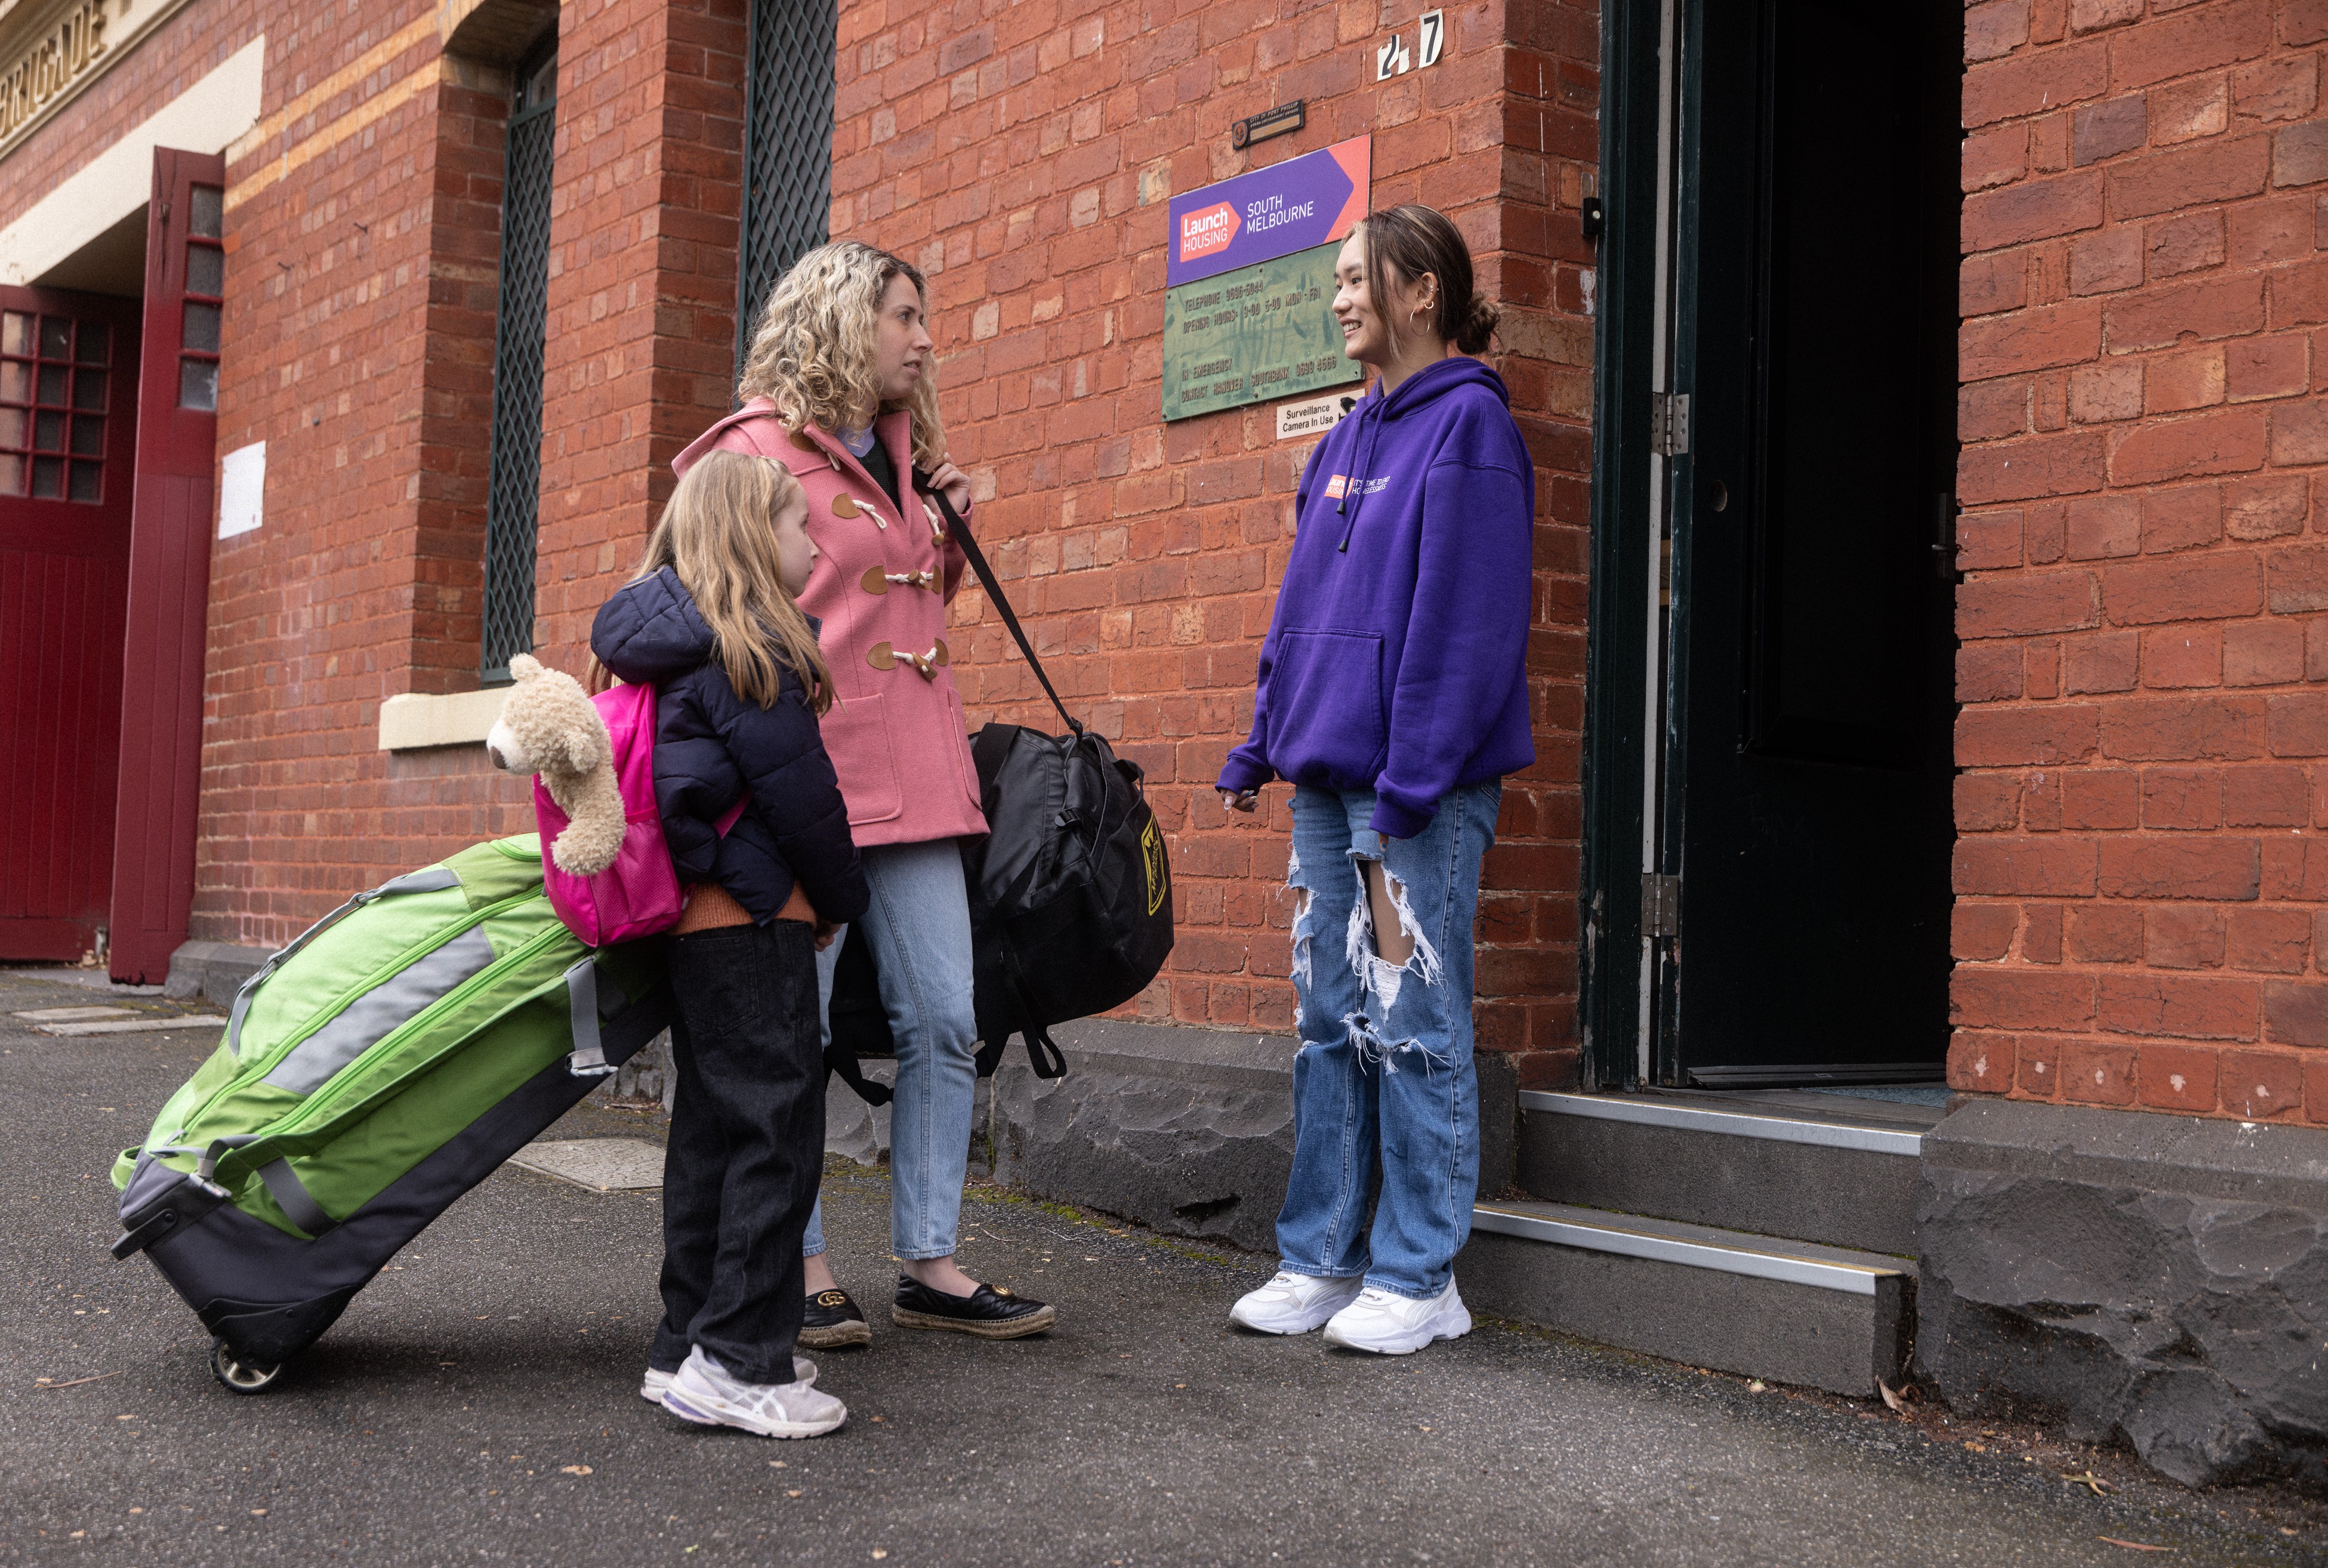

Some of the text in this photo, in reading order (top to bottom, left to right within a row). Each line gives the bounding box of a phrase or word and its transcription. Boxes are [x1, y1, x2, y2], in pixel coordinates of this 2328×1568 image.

[1268, 108, 1279, 116] PORT
[1281, 101, 1298, 112] PHILLIP
[1247, 193, 1282, 218] SOUTH
[1247, 200, 1314, 234] MELBOURNE
[1184, 207, 1228, 237] Launch
[1183, 227, 1228, 253] HOUSING
[1183, 315, 1210, 334] OPENING
[1285, 290, 1301, 307] MON
[1309, 285, 1321, 301] FRI
[1184, 291, 1220, 312] TELEPHONE
[1182, 357, 1232, 381] IN EMERGENCY
[1181, 385, 1208, 402] CONTACT
[1213, 376, 1243, 396] HANOVER
[1251, 365, 1290, 387] SOUTHBANK
[1283, 415, 1333, 432] Camera In Use
[1287, 405, 1330, 419] Surveillance
[1327, 486, 1343, 495] OUSIN
